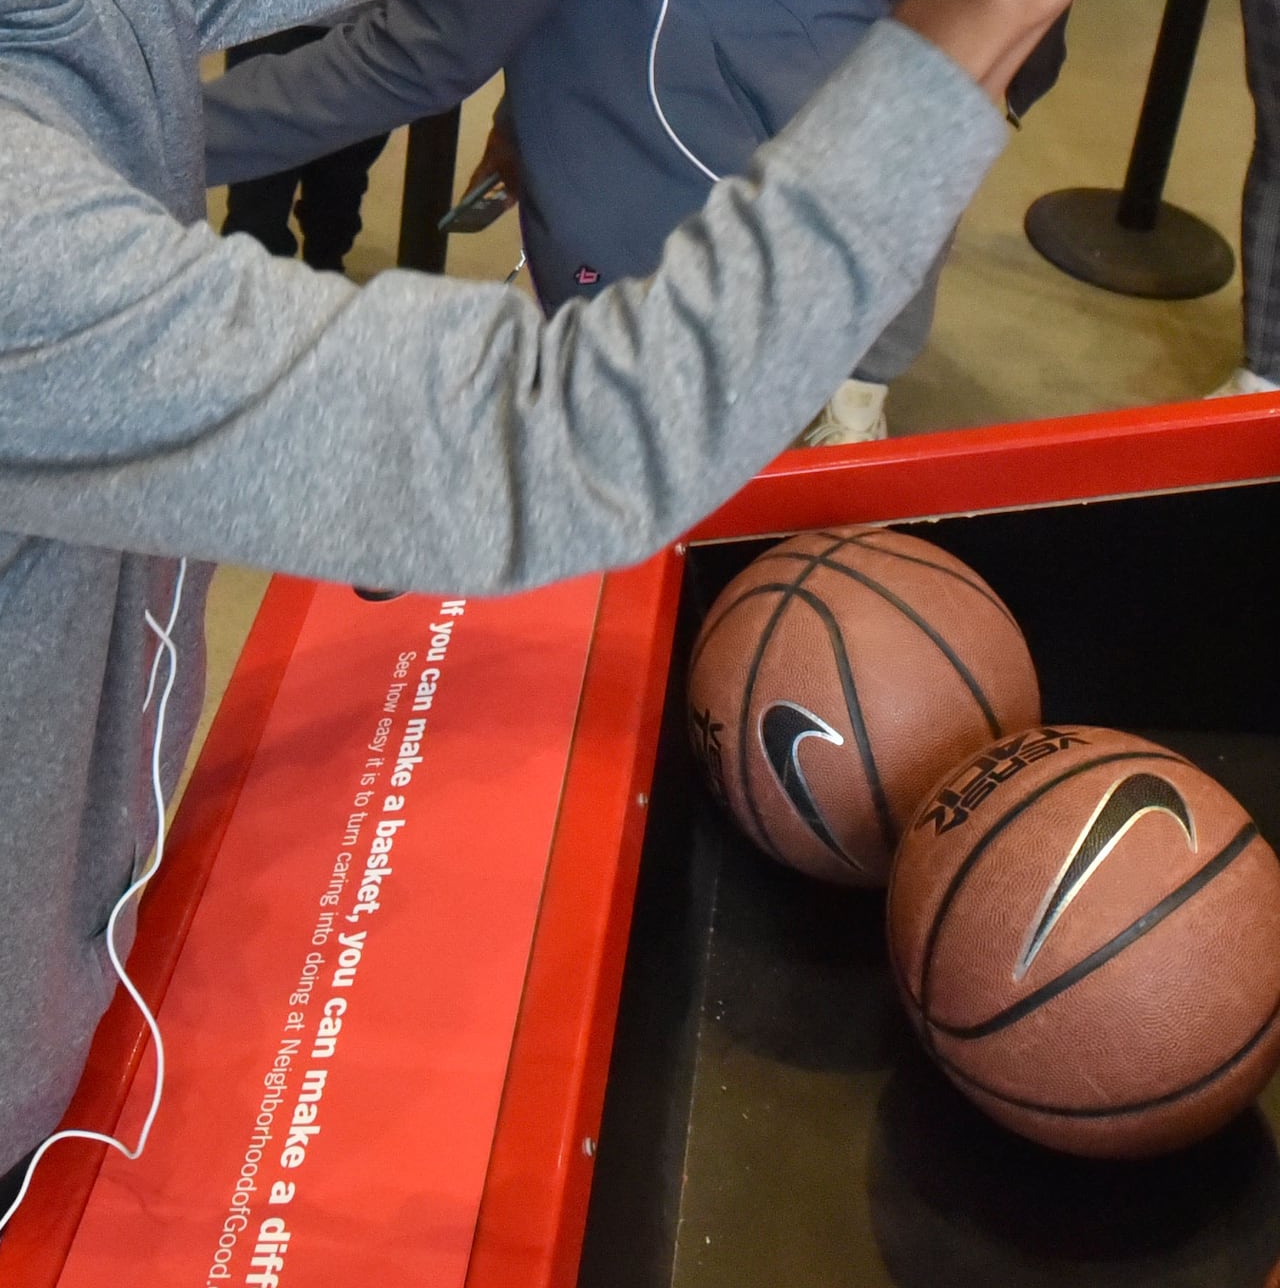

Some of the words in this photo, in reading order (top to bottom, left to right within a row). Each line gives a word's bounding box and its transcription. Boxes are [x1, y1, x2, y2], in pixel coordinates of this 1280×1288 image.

[439, 599, 467, 617] If
[426, 620, 455, 662] you
[392, 650, 418, 678] See
[382, 683, 408, 713] how
[411, 667, 441, 712] can
[368, 718, 392, 752] easy
[365, 757, 385, 768] it
[390, 718, 427, 787] make
[360, 773, 379, 786] is
[354, 790, 375, 807] to
[382, 794, 405, 812] a
[342, 811, 368, 846] turn
[319, 852, 352, 907] caring
[345, 818, 406, 923] basket,
[311, 912, 336, 946] into
[331, 930, 368, 988] you
[289, 952, 325, 1006] doing
[284, 1011, 305, 1032] at
[311, 997, 348, 1059] can
[280, 1069, 321, 1169] make
[206, 1039, 302, 1288] NeighborhoodofGood.
[268, 1180, 296, 1205] a
